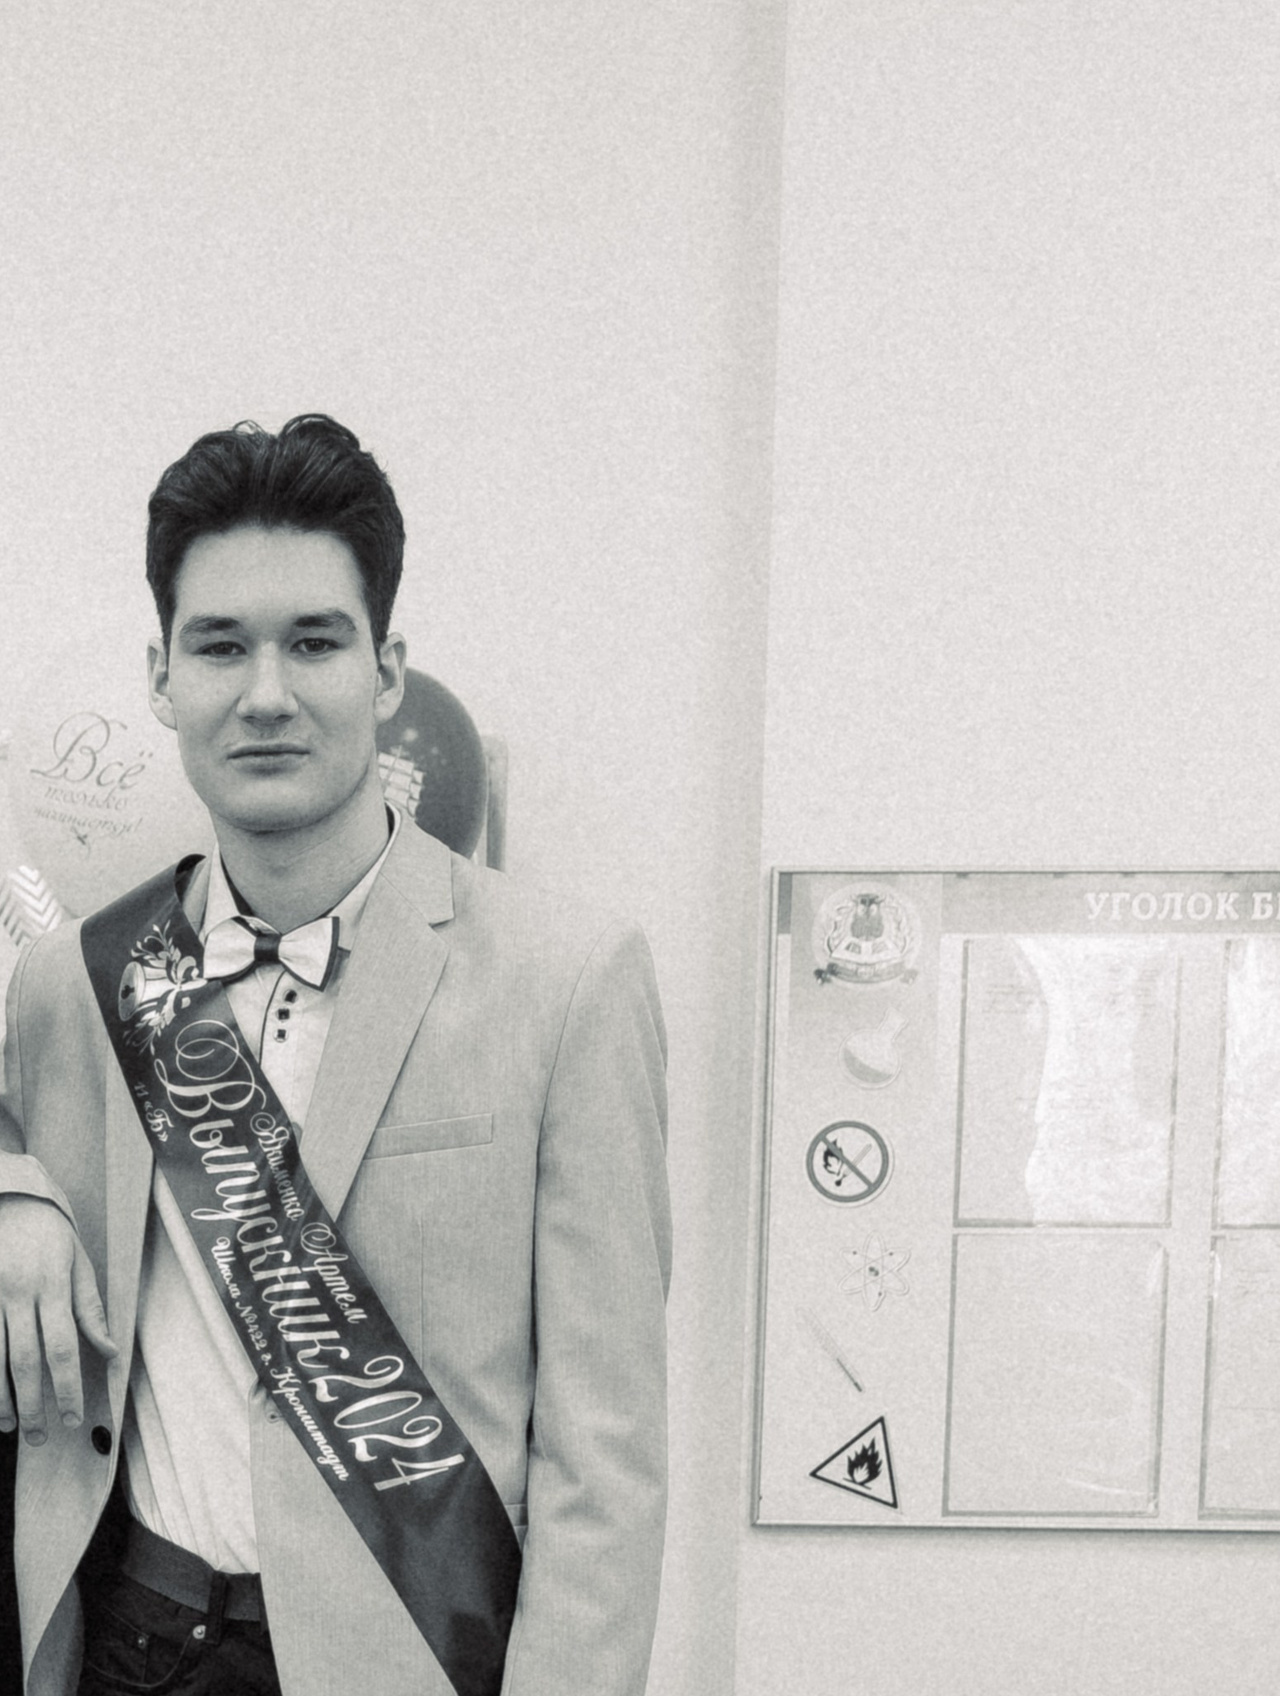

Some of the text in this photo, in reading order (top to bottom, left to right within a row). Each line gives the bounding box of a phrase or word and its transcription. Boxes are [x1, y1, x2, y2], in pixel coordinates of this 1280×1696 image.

[30, 711, 154, 790] Всё
[1085, 891, 1240, 921] УГОЛОК
[135, 1083, 149, 1097] 11
[154, 1019, 465, 1491] Выпускник 2024
[249, 1112, 368, 1324] Якименко Артем
[211, 1236, 242, 1299] Школа
[270, 1365, 350, 1482] Кронштадт
